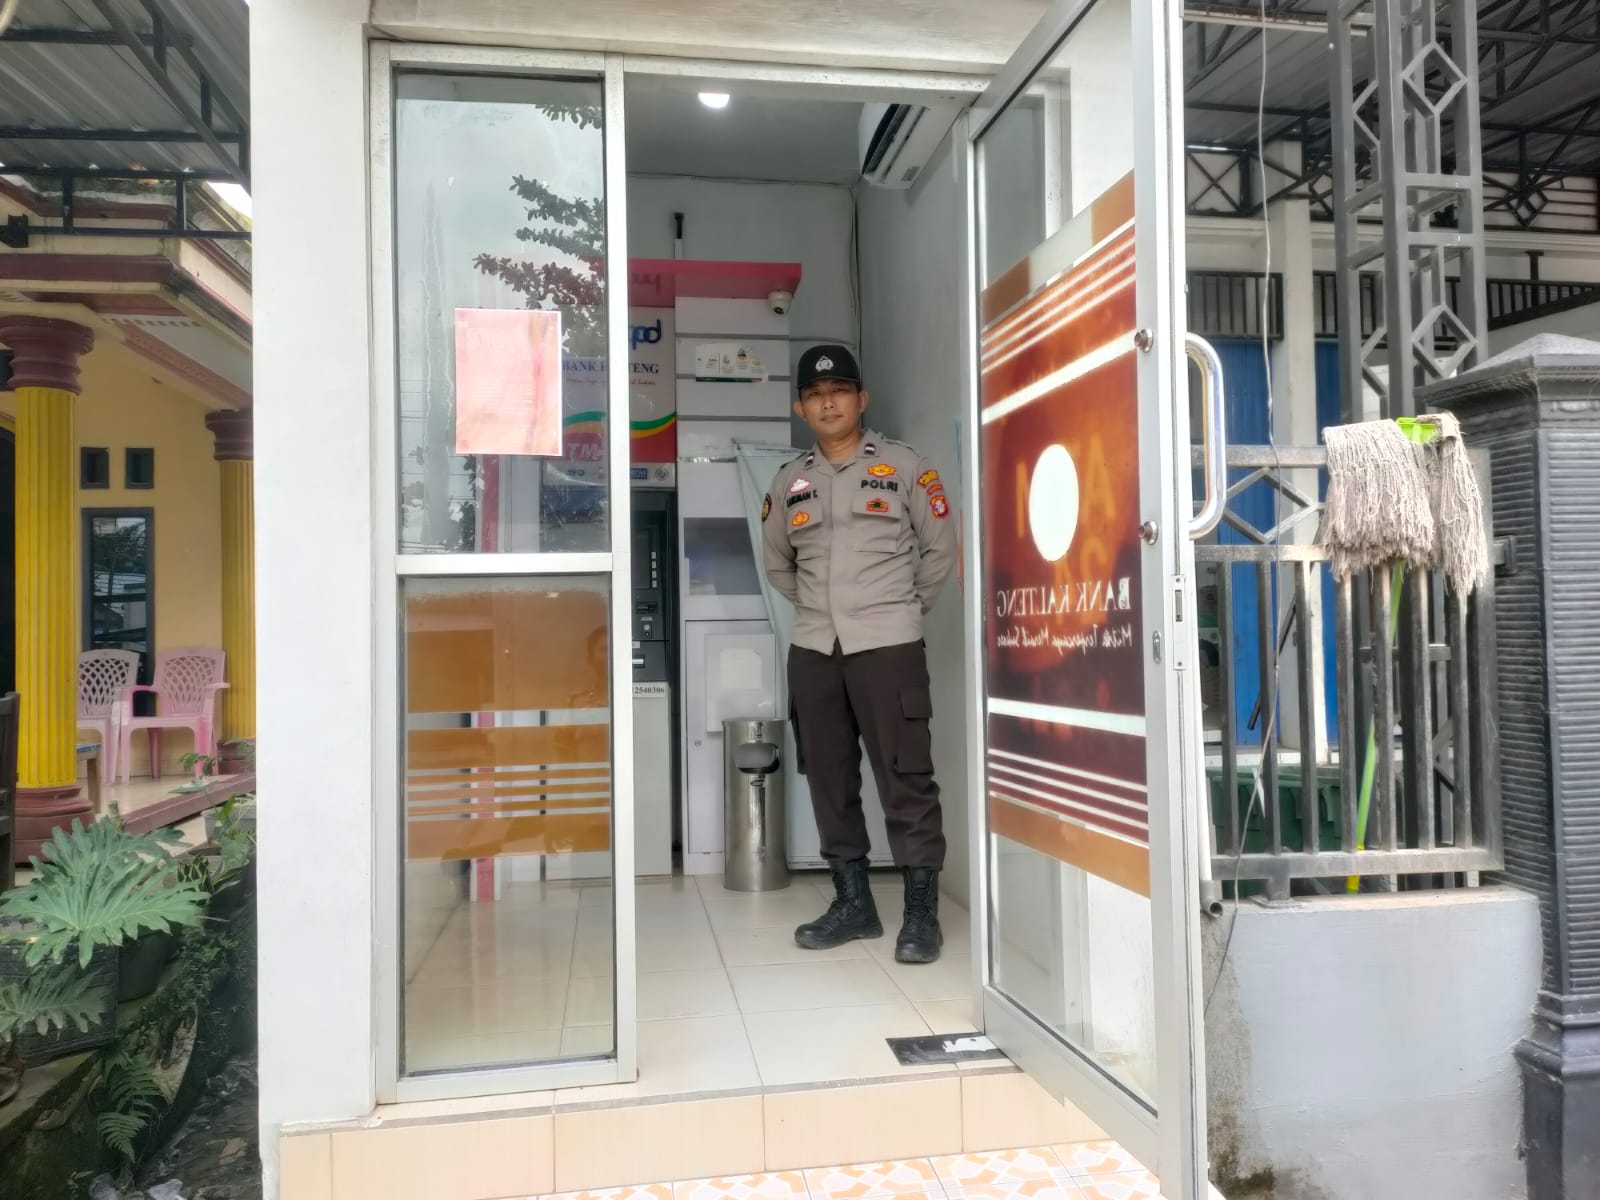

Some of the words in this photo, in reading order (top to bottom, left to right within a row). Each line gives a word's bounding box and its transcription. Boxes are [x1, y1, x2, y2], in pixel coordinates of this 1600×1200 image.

[631, 317, 662, 350] pd
[562, 360, 597, 372] BANK
[861, 479, 898, 493] POLRI
